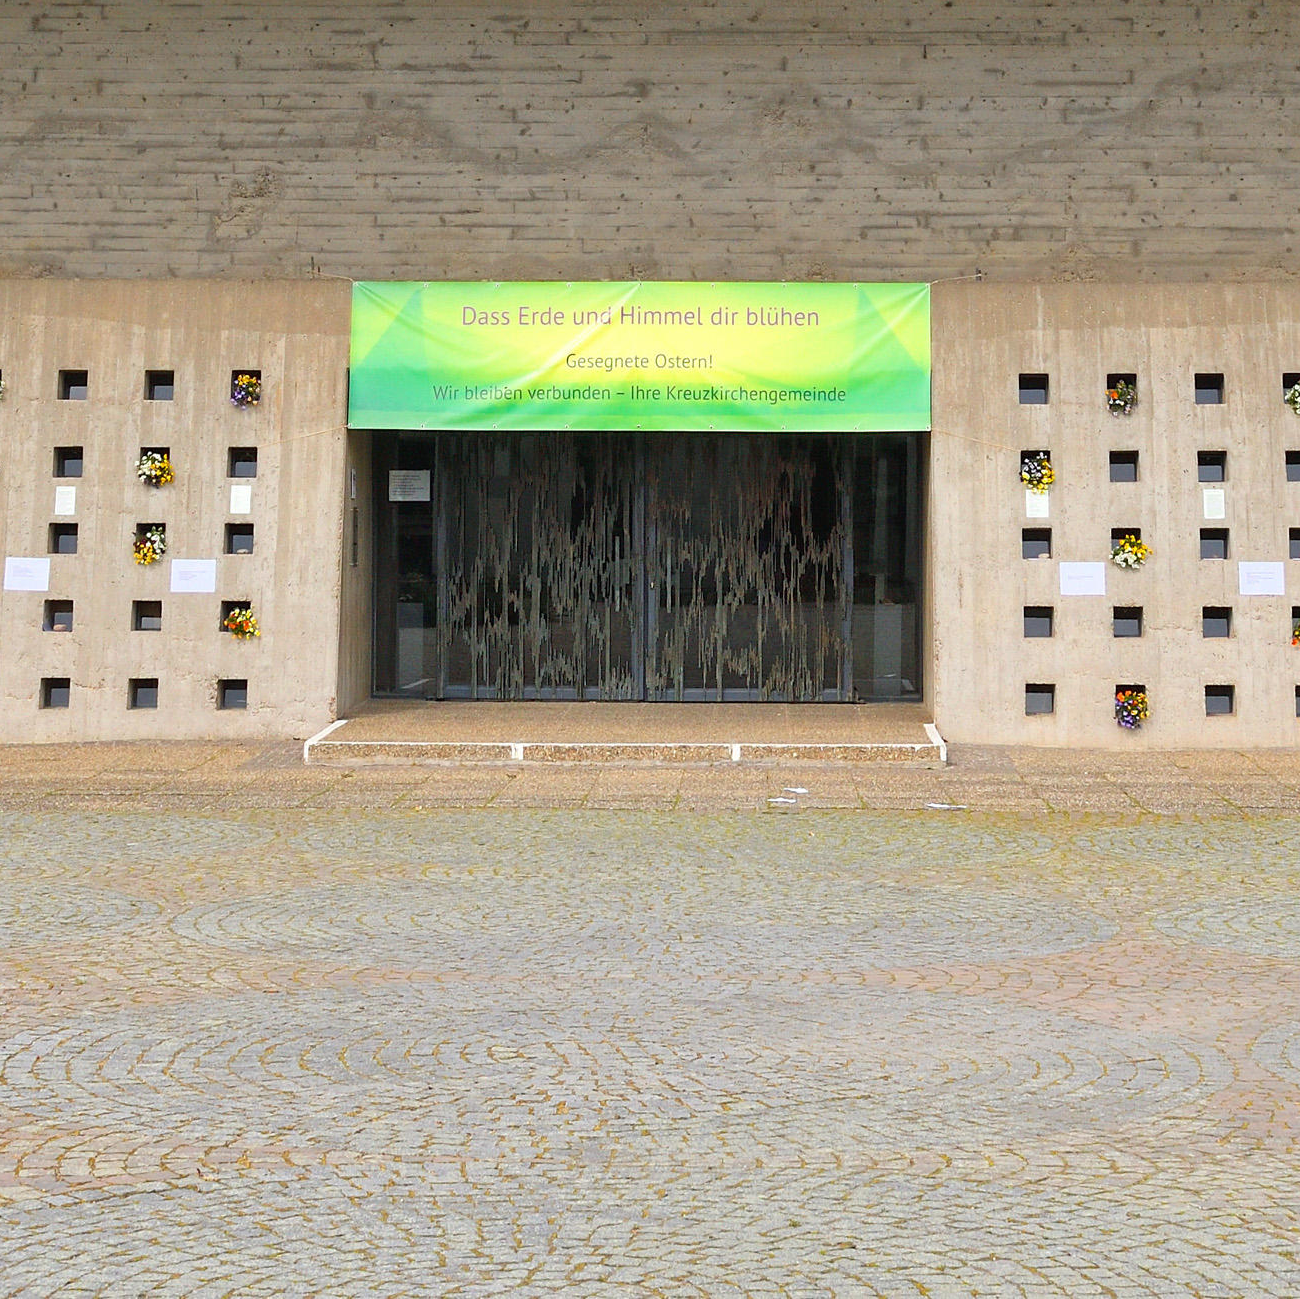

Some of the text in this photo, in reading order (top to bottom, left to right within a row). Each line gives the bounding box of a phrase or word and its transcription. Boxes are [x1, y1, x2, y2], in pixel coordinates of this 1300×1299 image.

[462, 306, 819, 326] Dass Erde und Himmel dir blühen
[566, 353, 713, 372] Gesegnete Ostern!
[433, 386, 459, 400] Wir
[464, 386, 522, 400] bleiben
[528, 386, 611, 400] verbunden
[631, 386, 661, 401] Ihre
[667, 386, 846, 404] Kreuzkirchengemeinde
